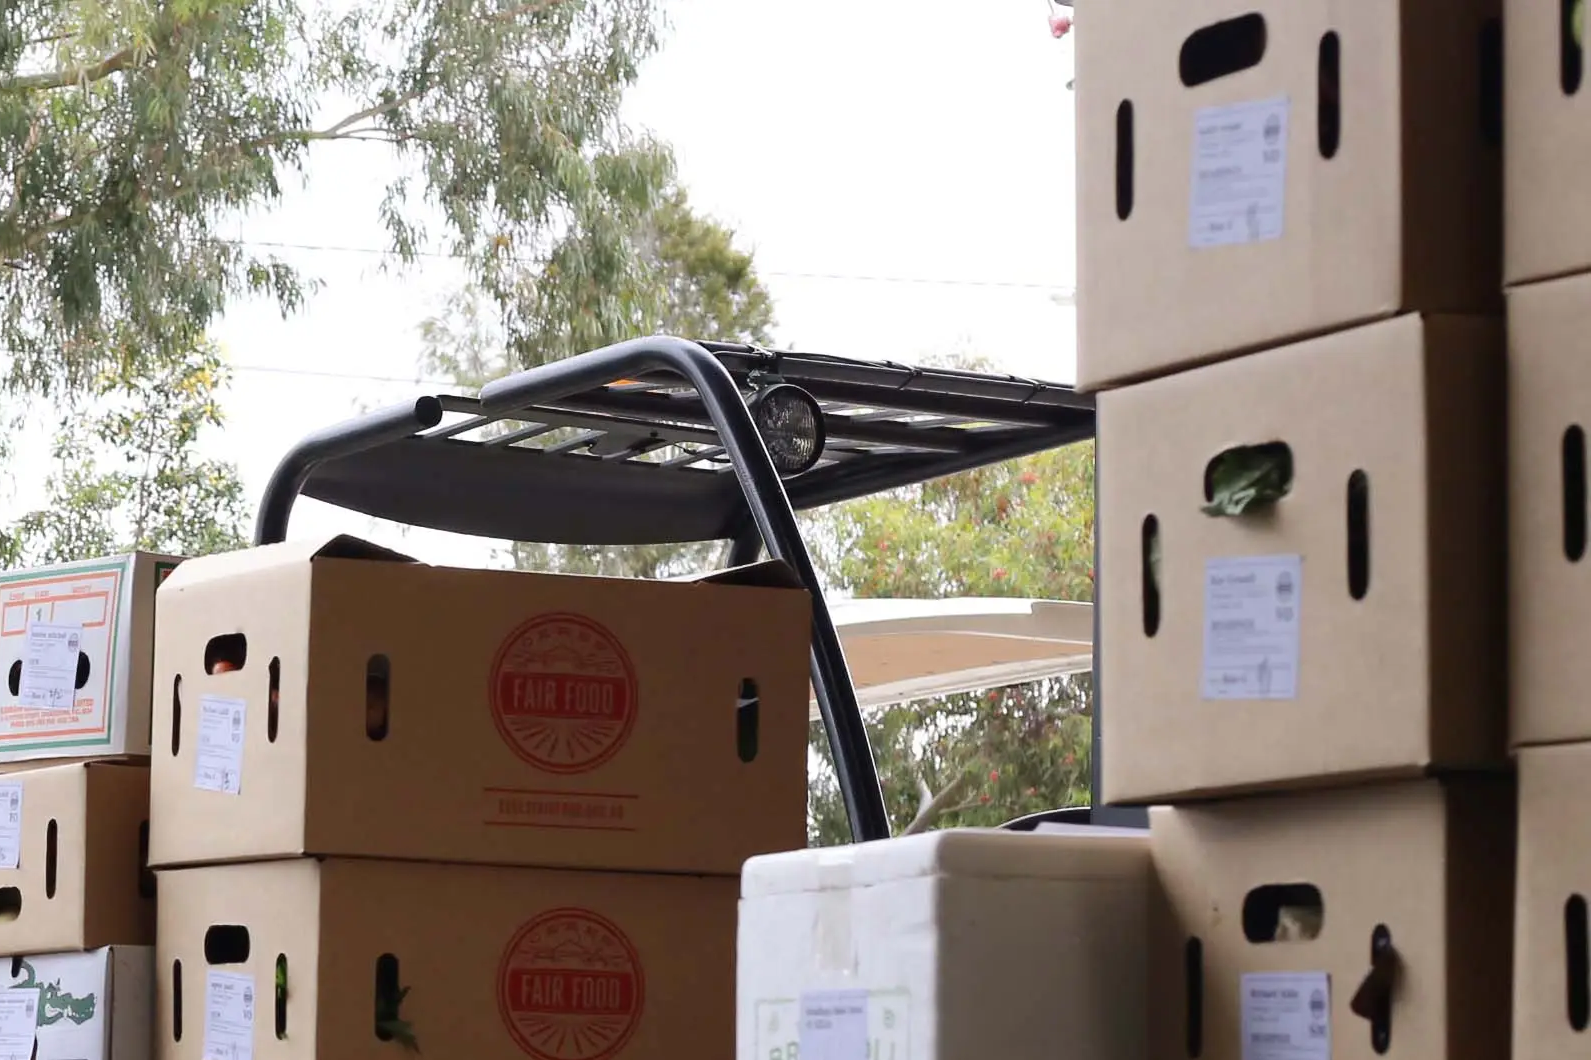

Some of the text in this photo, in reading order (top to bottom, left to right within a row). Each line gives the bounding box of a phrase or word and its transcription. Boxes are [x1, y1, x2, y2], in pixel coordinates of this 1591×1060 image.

[512, 678, 614, 714] FAIR FOOD
[520, 974, 621, 1009] FAIR FOOD
